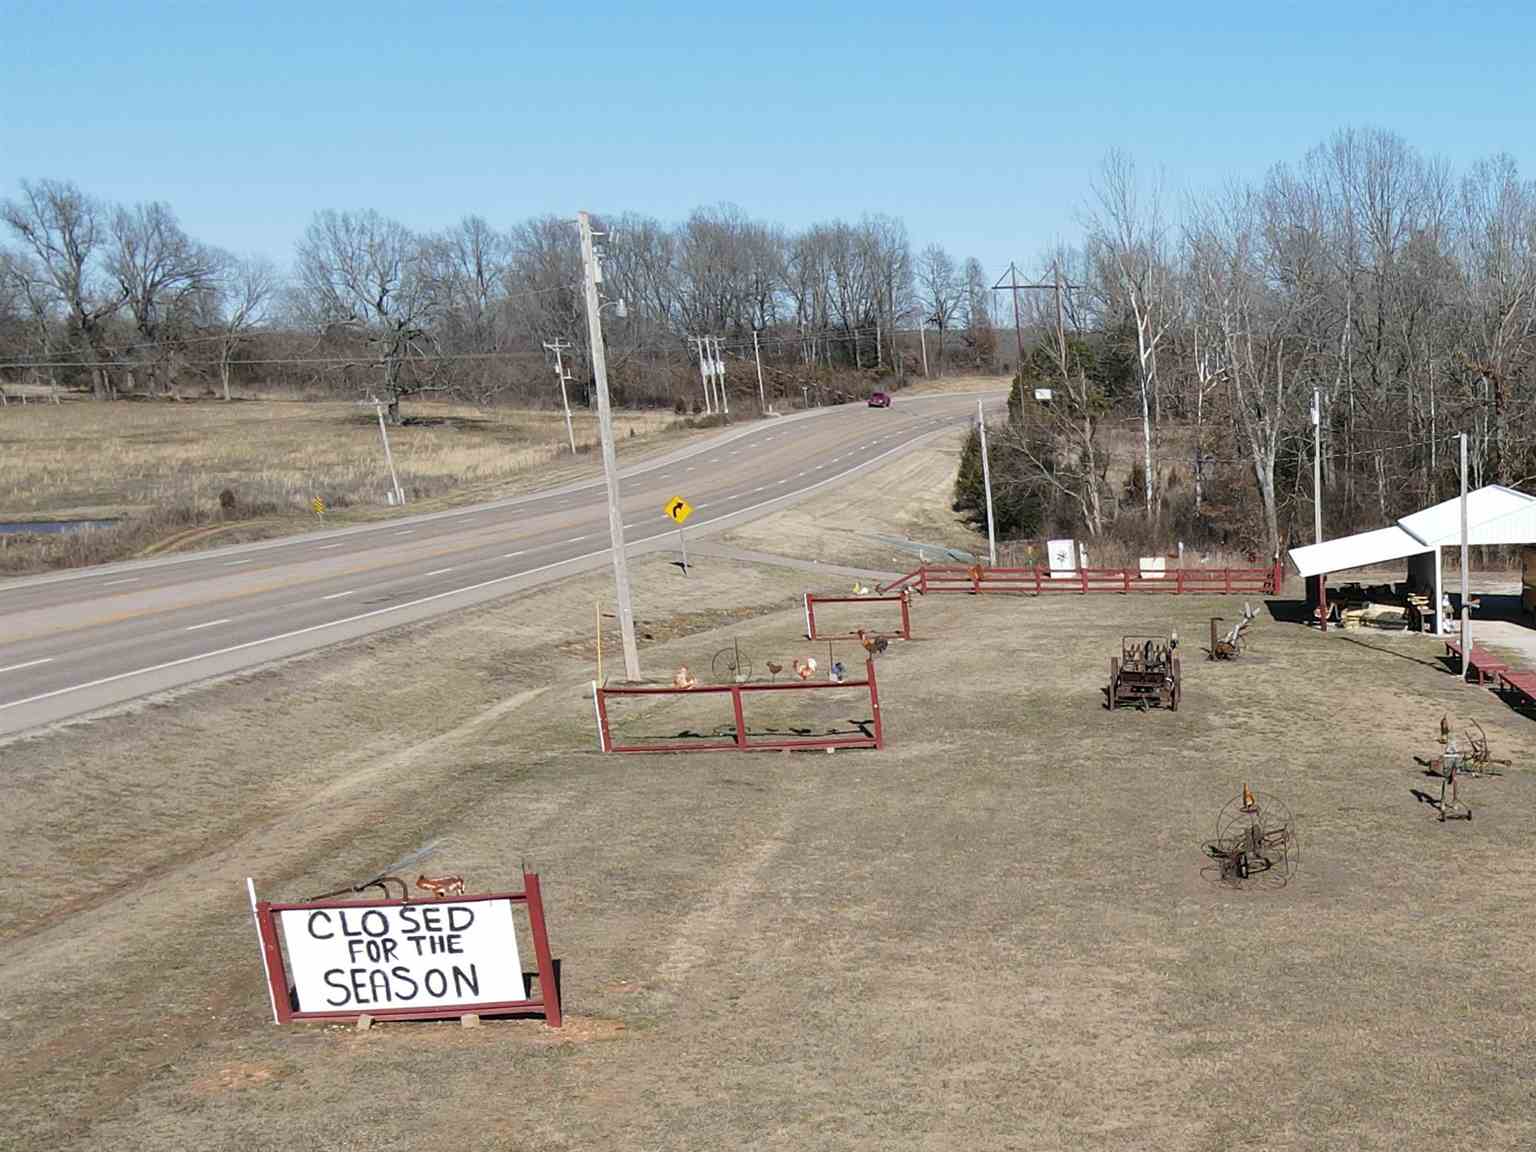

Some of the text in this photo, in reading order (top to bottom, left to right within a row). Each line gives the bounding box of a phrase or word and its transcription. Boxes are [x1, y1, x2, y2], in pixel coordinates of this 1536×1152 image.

[307, 906, 475, 940] CLOSED
[348, 934, 464, 963] FOR THE
[323, 963, 480, 1007] SEASON
